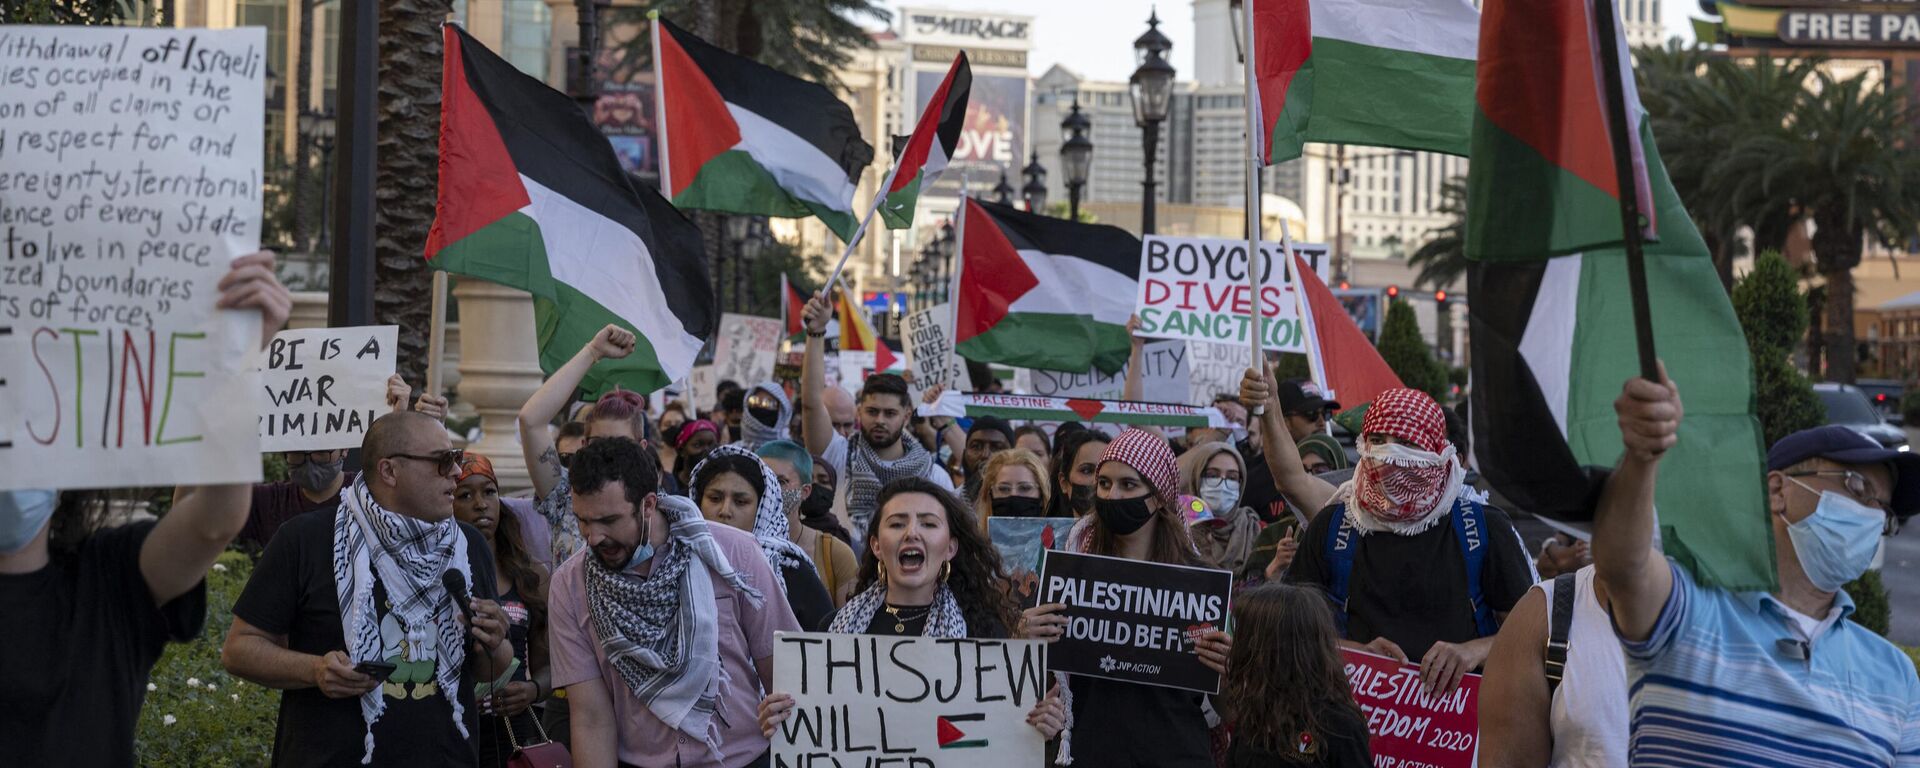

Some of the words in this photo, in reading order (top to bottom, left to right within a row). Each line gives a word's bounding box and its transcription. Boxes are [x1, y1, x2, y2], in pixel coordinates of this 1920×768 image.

[920, 17, 1028, 39] MIRAGE
[1788, 13, 1871, 40] FREE
[142, 37, 179, 63] of
[181, 36, 260, 80] Israeli
[46, 62, 143, 91] occupied
[150, 70, 172, 93] in
[187, 76, 232, 102] the
[34, 91, 66, 117] of
[73, 91, 98, 115] all
[109, 92, 182, 121] claims
[194, 104, 231, 124] or
[17, 123, 122, 163] respect
[132, 121, 178, 152] for
[188, 132, 237, 160] and
[954, 129, 1013, 161] OVE
[64, 194, 93, 223] of
[99, 203, 163, 238] every
[176, 201, 246, 237] State
[4, 226, 39, 260] to
[46, 230, 86, 264] live
[97, 236, 125, 260] in
[137, 240, 212, 267] peace
[1148, 240, 1327, 284] BOYCOTT
[57, 265, 194, 301] boundaries
[29, 292, 61, 320] of
[908, 311, 932, 331] GET
[320, 338, 342, 360] IS
[356, 336, 380, 360] A
[908, 324, 943, 347] YOUR
[920, 353, 944, 375] OFF
[265, 375, 337, 407] WAR
[972, 394, 1052, 409] PALESTINE
[1118, 402, 1197, 416] PALESTINE
[1047, 575, 1222, 622] PALESTINIANS
[1134, 624, 1163, 649] BE
[1182, 625, 1219, 638] PALESTINIAN
[782, 637, 930, 703] THIS
[935, 638, 1044, 707] JEW
[1116, 660, 1132, 671] JVP
[1132, 663, 1162, 675] ACTION
[781, 704, 917, 754] WILL
[1427, 728, 1473, 751] 2020
